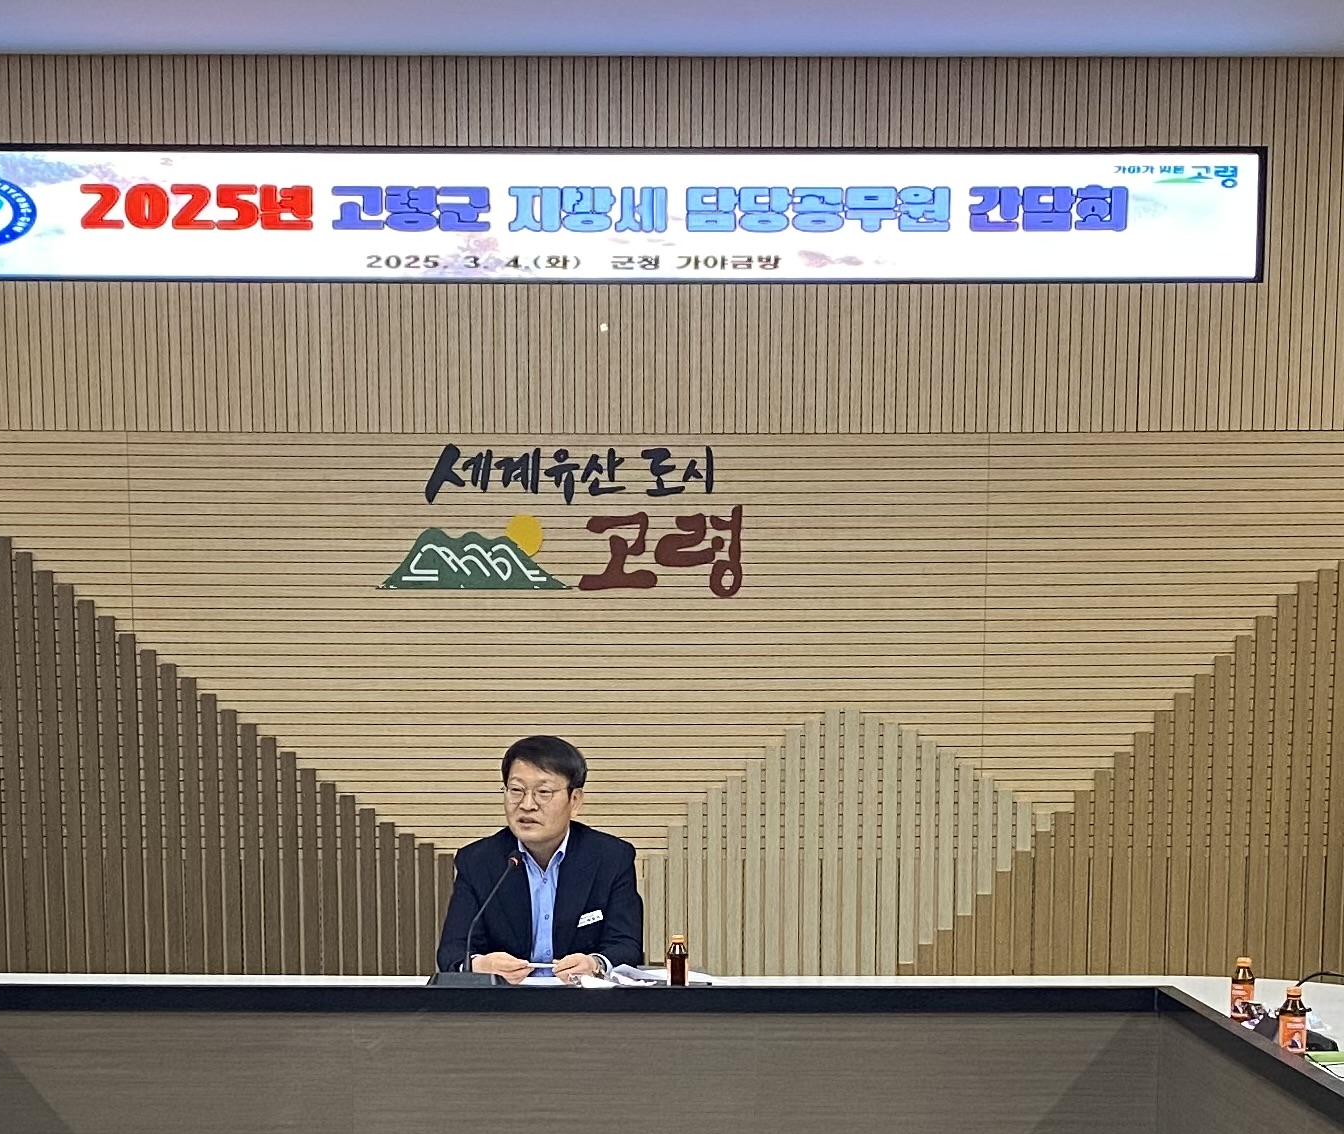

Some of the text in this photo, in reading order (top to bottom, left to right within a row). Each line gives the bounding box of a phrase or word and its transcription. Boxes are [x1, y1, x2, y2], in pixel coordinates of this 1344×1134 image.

[1187, 165, 1239, 189] 고령
[80, 184, 1130, 233] 2025년 고령군 지방세 담당공무원 간담회
[366, 255, 449, 270] 2025.
[463, 255, 489, 270] 3.
[676, 255, 782, 271] 가야금방
[424, 443, 714, 505] 세계유산 도시
[578, 504, 743, 598] 고령
